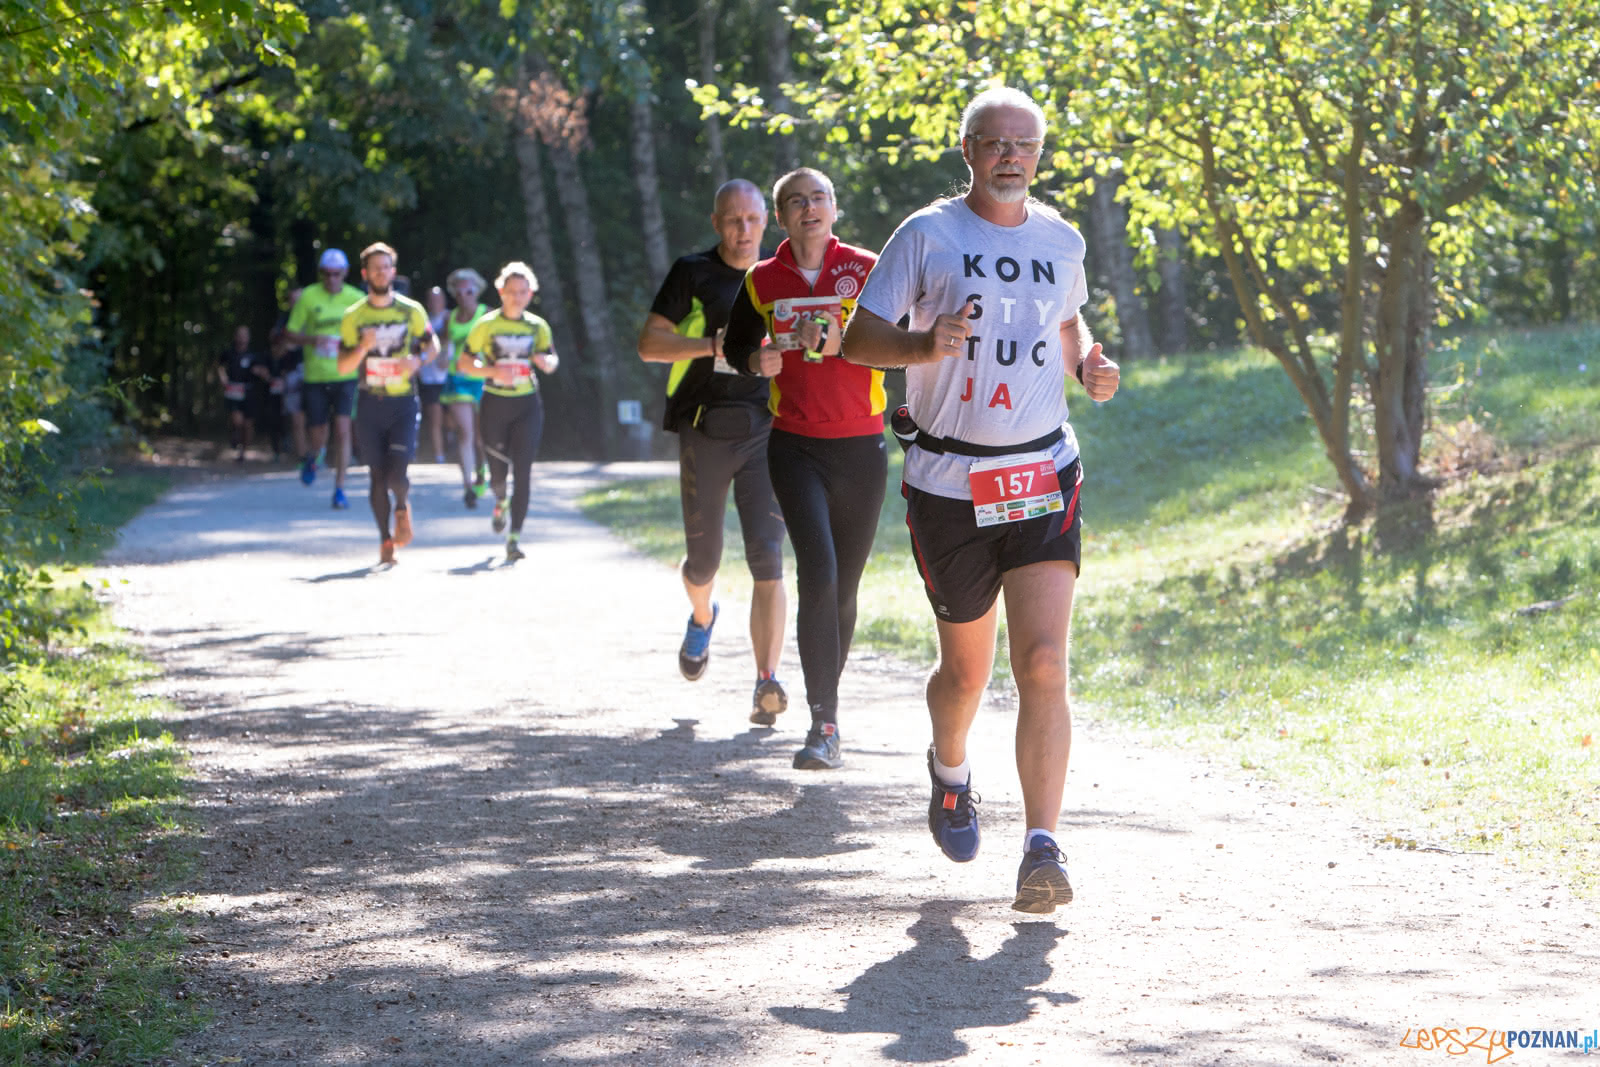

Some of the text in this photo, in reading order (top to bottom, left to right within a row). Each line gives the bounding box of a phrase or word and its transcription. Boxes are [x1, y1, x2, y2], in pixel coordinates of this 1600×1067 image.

[963, 254, 1056, 285] KON
[966, 293, 1056, 326] STY
[965, 335, 1047, 367] TUC
[960, 377, 1013, 410] JA
[993, 470, 1035, 497] 157
